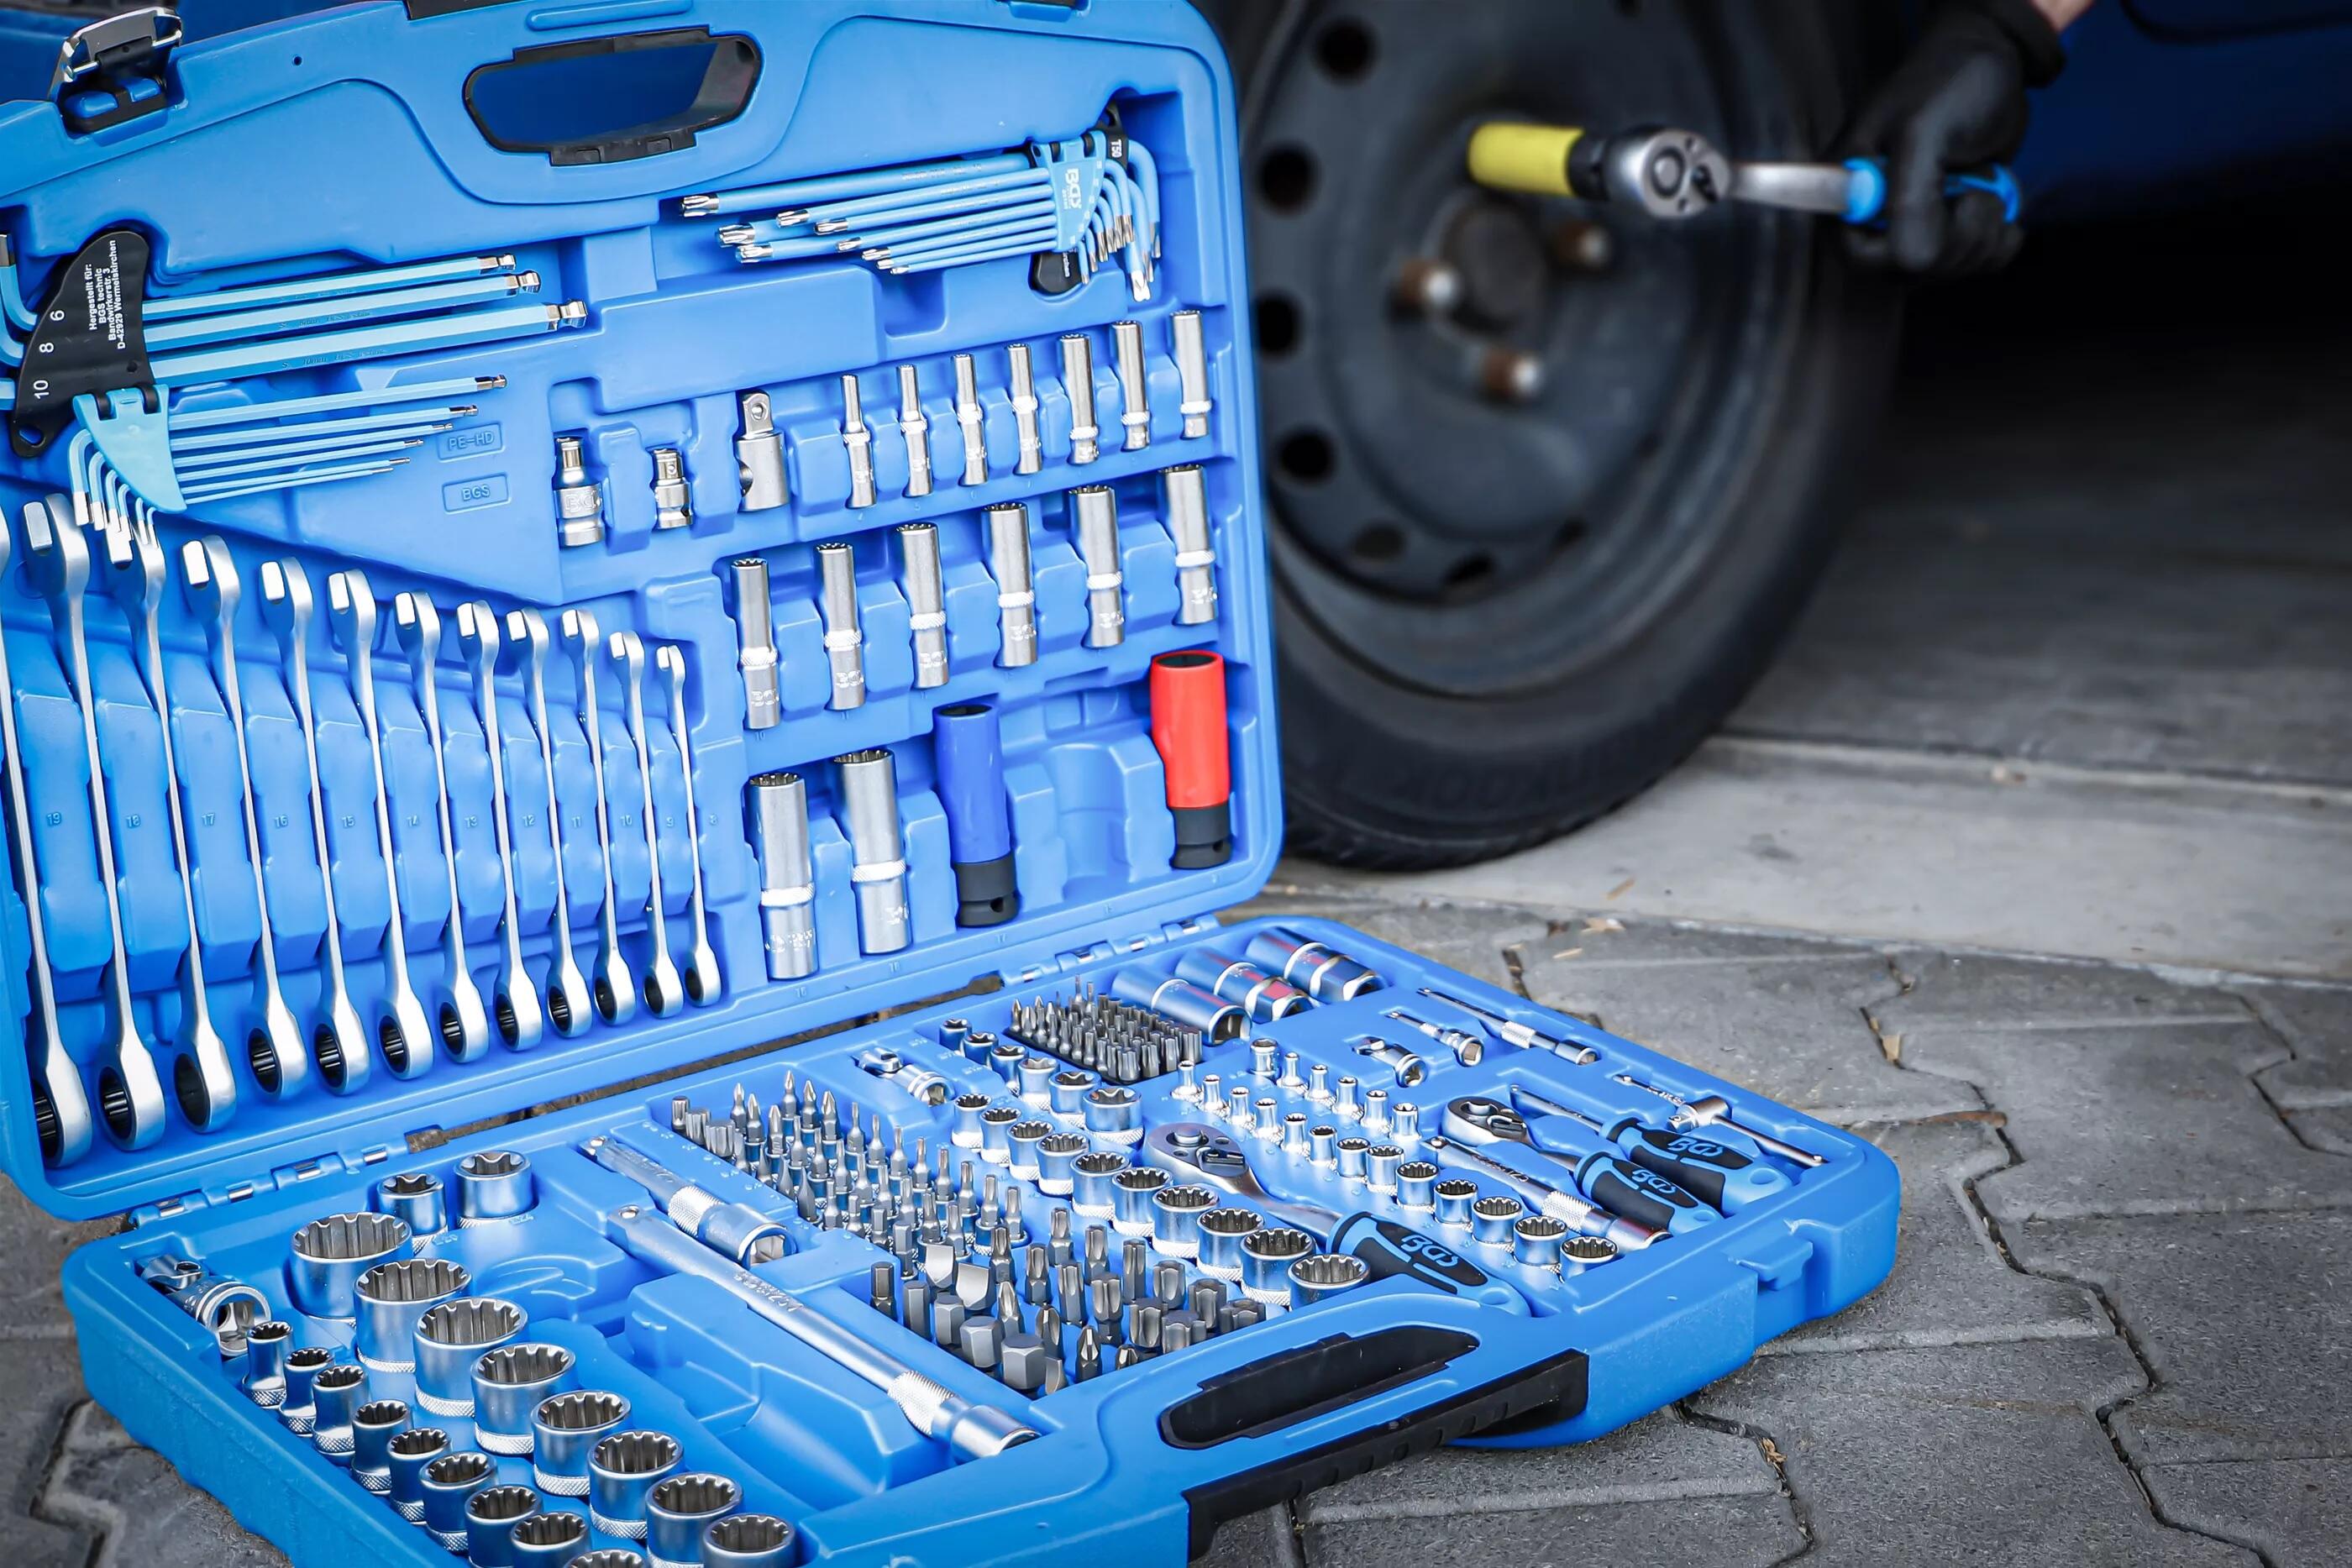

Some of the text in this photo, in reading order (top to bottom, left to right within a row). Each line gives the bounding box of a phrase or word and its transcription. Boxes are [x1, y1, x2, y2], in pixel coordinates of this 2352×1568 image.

[1110, 139, 1123, 159] T50
[84, 264, 97, 330] Hergestellt für:
[94, 268, 107, 323] BGS technic
[109, 239, 126, 349] D-42929 Wermelskirchen
[50, 310, 65, 322] 6
[104, 275, 117, 341] Bandwirkerstr.
[39, 342, 55, 353] 8
[34, 380, 49, 399] 10
[448, 431, 495, 451] PE-HD
[463, 484, 491, 501] BGS
[47, 811, 62, 826] 19
[126, 814, 141, 828] 18
[202, 812, 215, 826] 17
[274, 815, 288, 829] 16
[341, 815, 354, 829] 15
[522, 814, 535, 827] 12
[621, 814, 633, 826] 10
[1667, 1136, 1724, 1157] BGS
[1631, 1168, 1677, 1193] BGS
[1400, 1235, 1458, 1267] BGS
